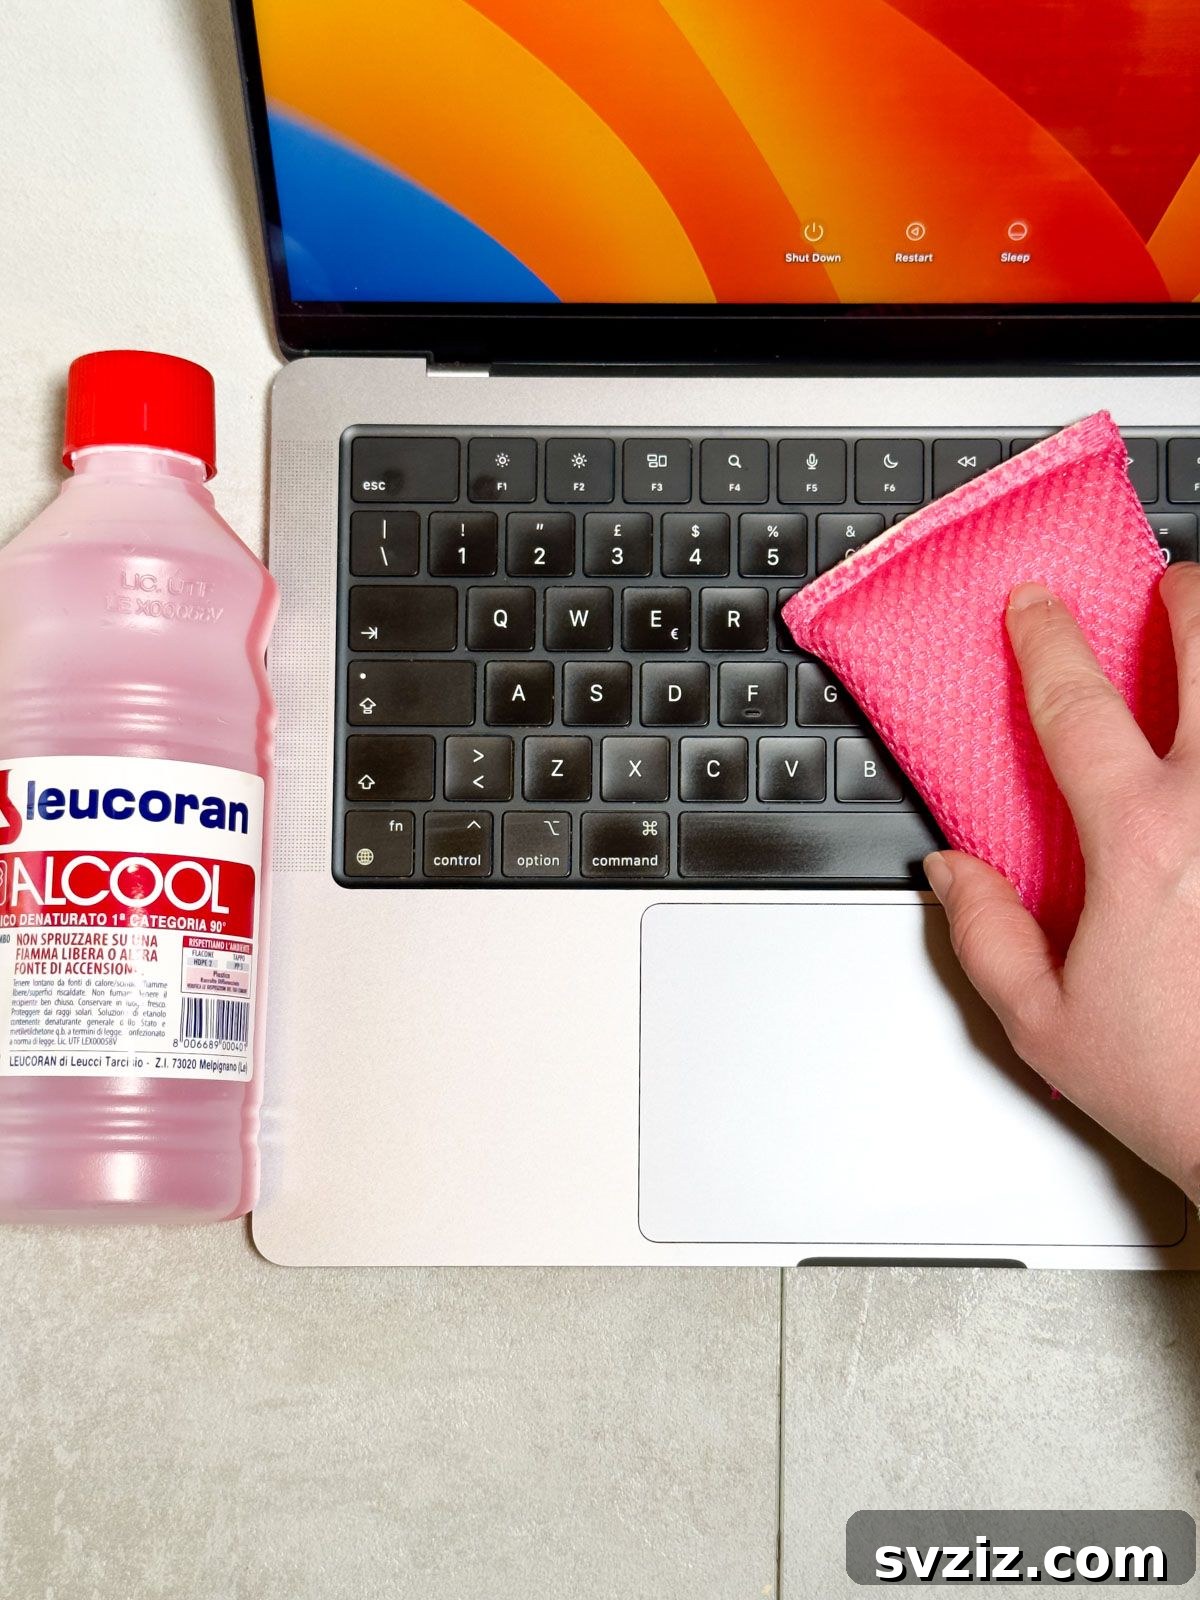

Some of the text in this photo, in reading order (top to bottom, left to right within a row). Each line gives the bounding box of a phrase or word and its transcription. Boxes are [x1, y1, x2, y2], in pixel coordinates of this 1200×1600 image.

[785, 253, 841, 263] Shut Down
[895, 253, 934, 263] Restart
[1000, 252, 1031, 265] Sleep
[362, 481, 386, 491] esc
[497, 482, 507, 491] F1
[573, 482, 585, 492] F2
[651, 482, 663, 492] F3
[729, 483, 741, 492] F4
[806, 483, 818, 493] F5
[884, 483, 896, 492] F6
[613, 524, 622, 537] £
[691, 524, 700, 538] $
[766, 524, 779, 538] %
[845, 525, 856, 538] &
[458, 547, 466, 565] 1
[534, 547, 546, 565] 2
[611, 547, 624, 565] 3
[689, 548, 702, 565] 4
[767, 548, 779, 566] 5
[493, 609, 508, 629] Q
[569, 609, 589, 627] W
[650, 610, 662, 628] E
[727, 610, 741, 628] R
[670, 627, 679, 640] €
[511, 684, 526, 702] A
[590, 683, 603, 702] S
[668, 684, 682, 702] D
[747, 684, 759, 702] F
[823, 685, 838, 703] G
[551, 759, 564, 777] Z
[628, 759, 642, 777] X
[706, 759, 721, 778] C
[784, 760, 799, 778] V
[863, 760, 877, 778] B
[26, 780, 249, 834] leucoran
[389, 819, 403, 832] fn
[433, 854, 481, 866] control
[517, 854, 560, 868] option
[592, 854, 658, 867] command
[11, 855, 230, 915] ALCOOL
[20, 913, 107, 926] DENATURATO
[129, 914, 207, 931] CATEGORIA
[16, 933, 37, 946] NON
[41, 933, 108, 946] SPRUZZARE
[112, 933, 127, 946] SU
[15, 948, 58, 960] FIAMMA
[62, 948, 104, 960] LIBERA
[107, 948, 116, 961] O
[14, 962, 140, 976] FONTE DI ACCENSION
[32, 979, 55, 987] lontano
[57, 979, 65, 987] da
[67, 979, 82, 987] fonti
[85, 979, 91, 987] di
[91, 989, 105, 997] Non
[56, 1008, 71, 1017] raggi
[142, 1010, 167, 1018] etanolo
[86, 1019, 114, 1027] generale
[141, 1019, 157, 1027] Stato
[68, 1037, 80, 1045] UTF
[173, 1038, 179, 1048] 8
[183, 1038, 219, 1049] 006689
[9, 1056, 56, 1067] LEUCORAN
[60, 1056, 67, 1067] di
[70, 1056, 102, 1067] Leucci
[155, 1057, 169, 1068] Z.I.
[172, 1058, 197, 1070] 73020
[199, 1060, 237, 1073] Melpignano
